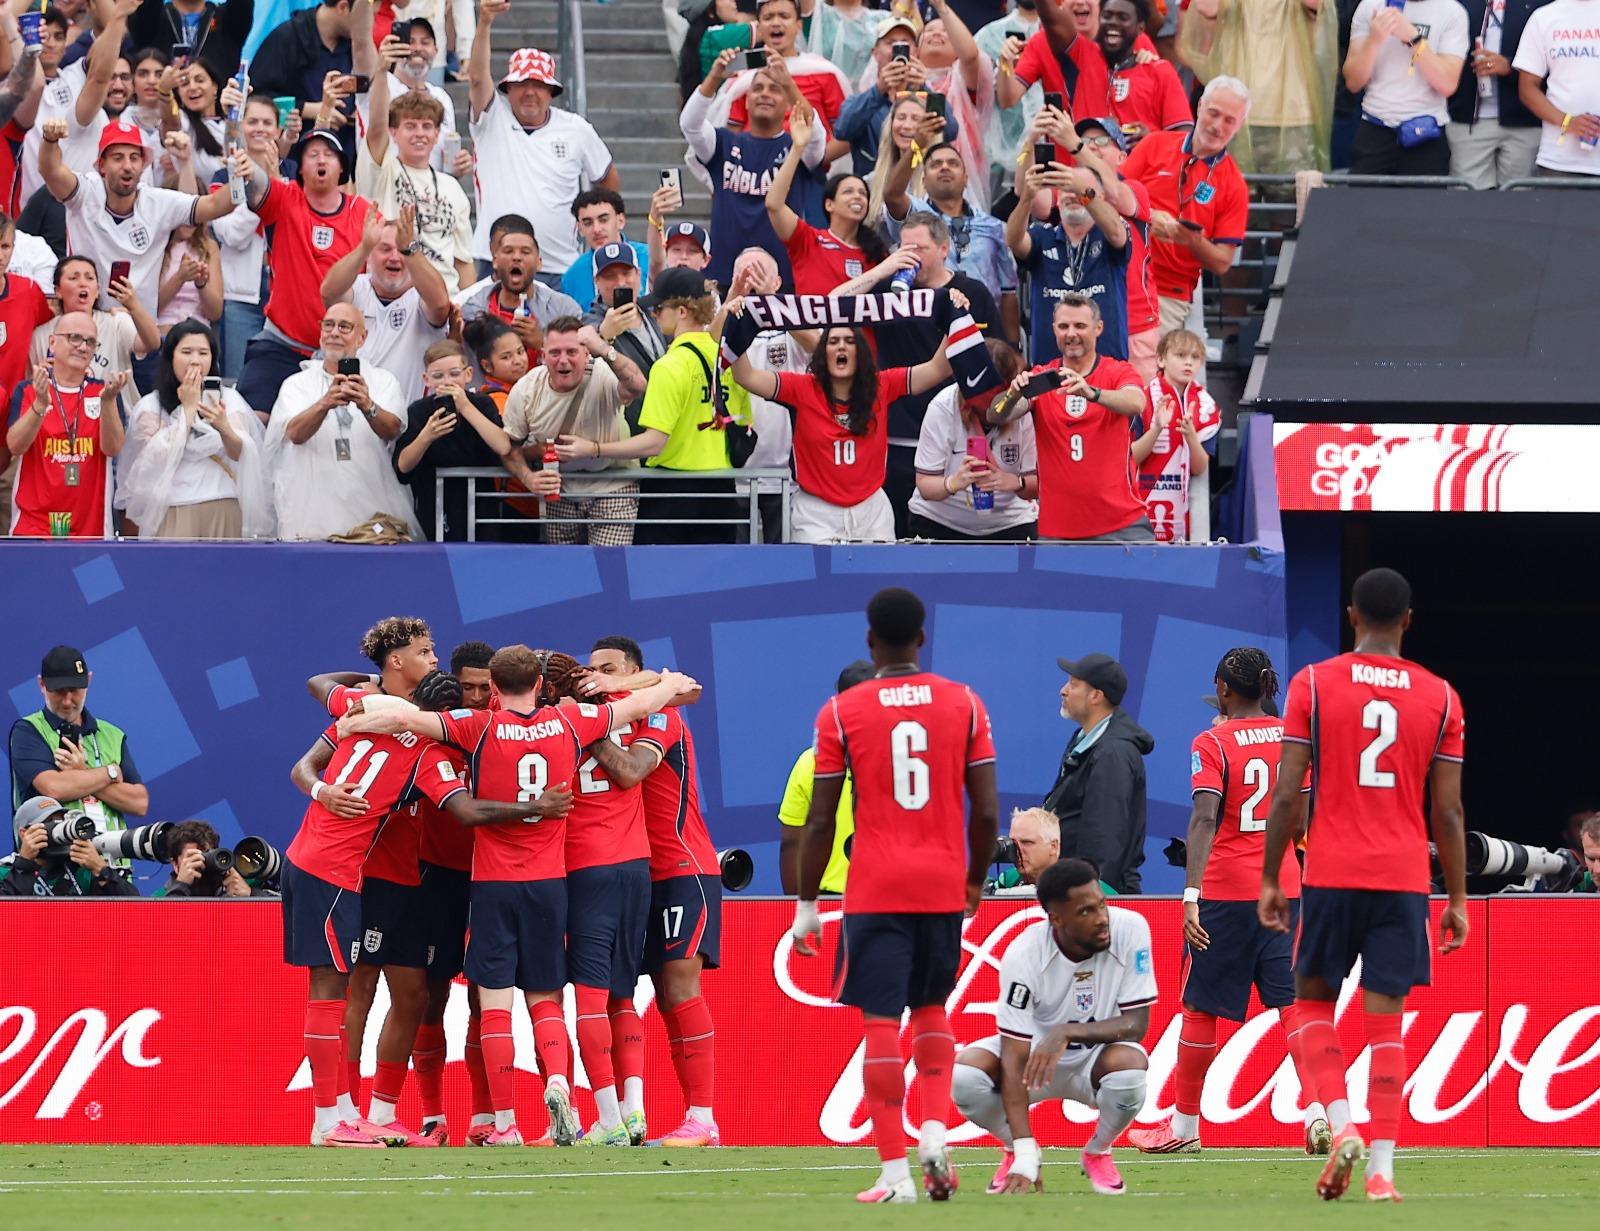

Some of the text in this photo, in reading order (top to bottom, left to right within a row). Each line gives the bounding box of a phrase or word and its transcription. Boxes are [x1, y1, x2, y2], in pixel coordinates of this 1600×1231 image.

[1549, 46, 1600, 60] CANAL
[1043, 284, 1105, 300] Snapagon
[744, 288, 935, 328] ENGLAND
[44, 437, 94, 457] AUSTIN
[833, 439, 856, 465] 10
[1070, 433, 1084, 462] 9
[1351, 663, 1411, 690] KONSA
[878, 683, 933, 707] GUÉHI
[496, 718, 565, 742] ANDERSON
[1358, 699, 1399, 788] 2
[333, 738, 390, 799] 11
[890, 719, 931, 810] 6
[517, 752, 549, 824] 8
[1239, 757, 1281, 833] 2
[662, 905, 684, 940] 17
